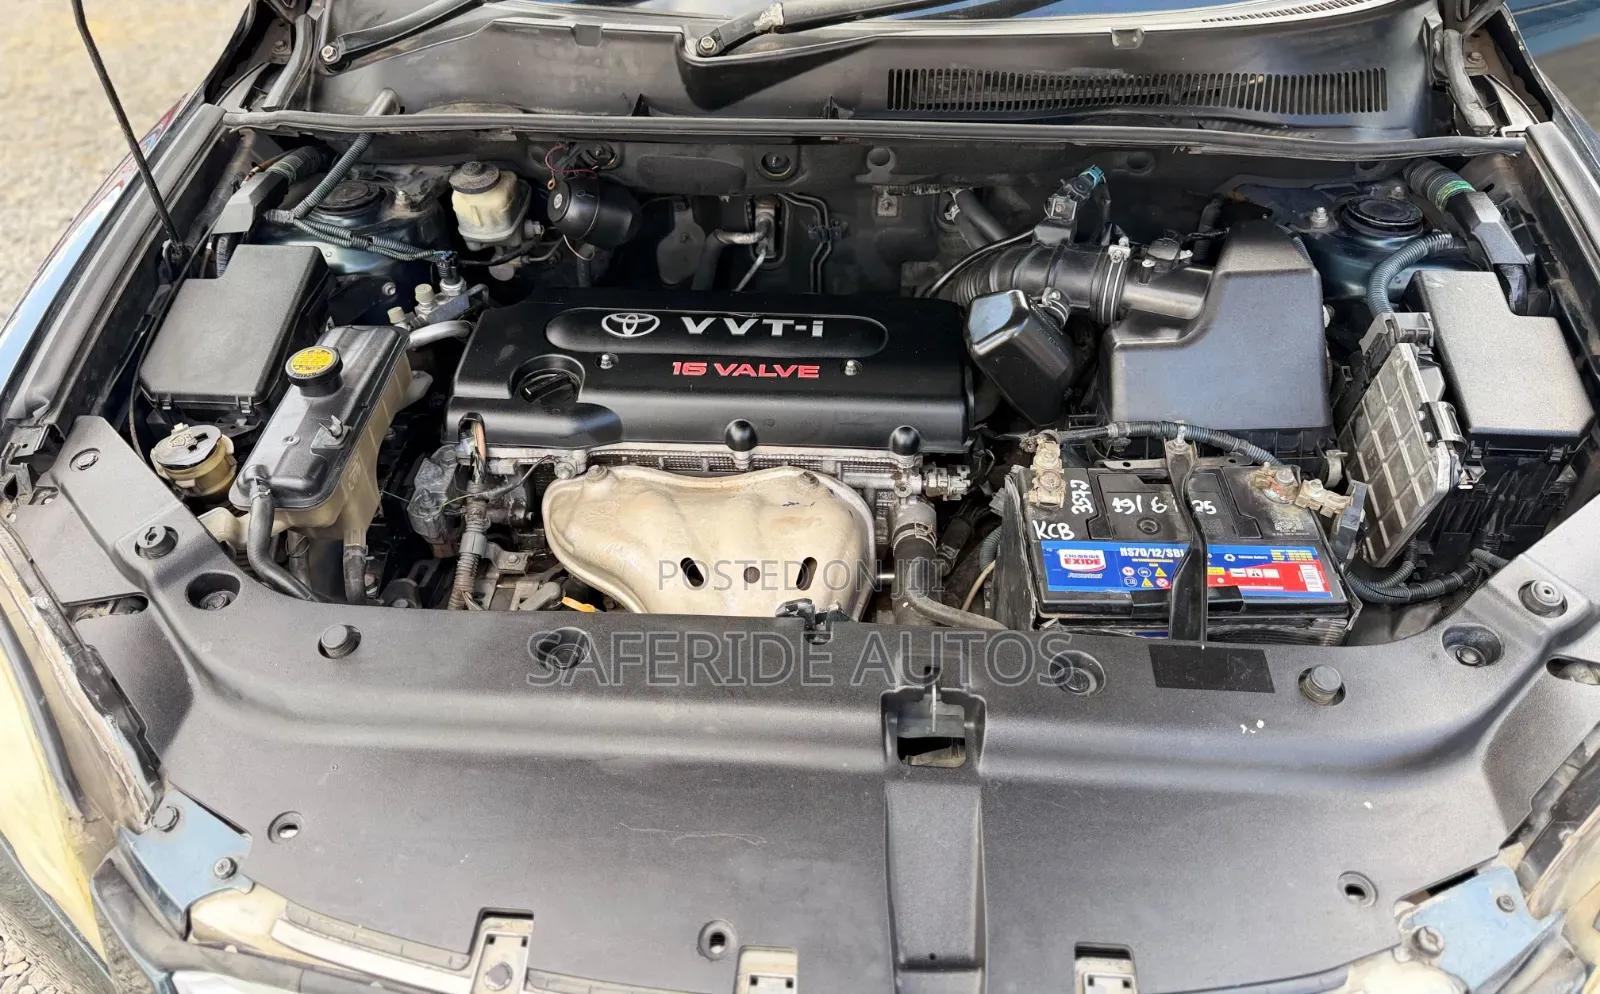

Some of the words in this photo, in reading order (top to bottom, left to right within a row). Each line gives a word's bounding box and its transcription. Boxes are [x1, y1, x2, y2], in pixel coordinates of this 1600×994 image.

[681, 316, 824, 338] VVT-i
[672, 361, 708, 376] 16
[713, 363, 820, 379] VALVE
[1032, 519, 1076, 540] KCB
